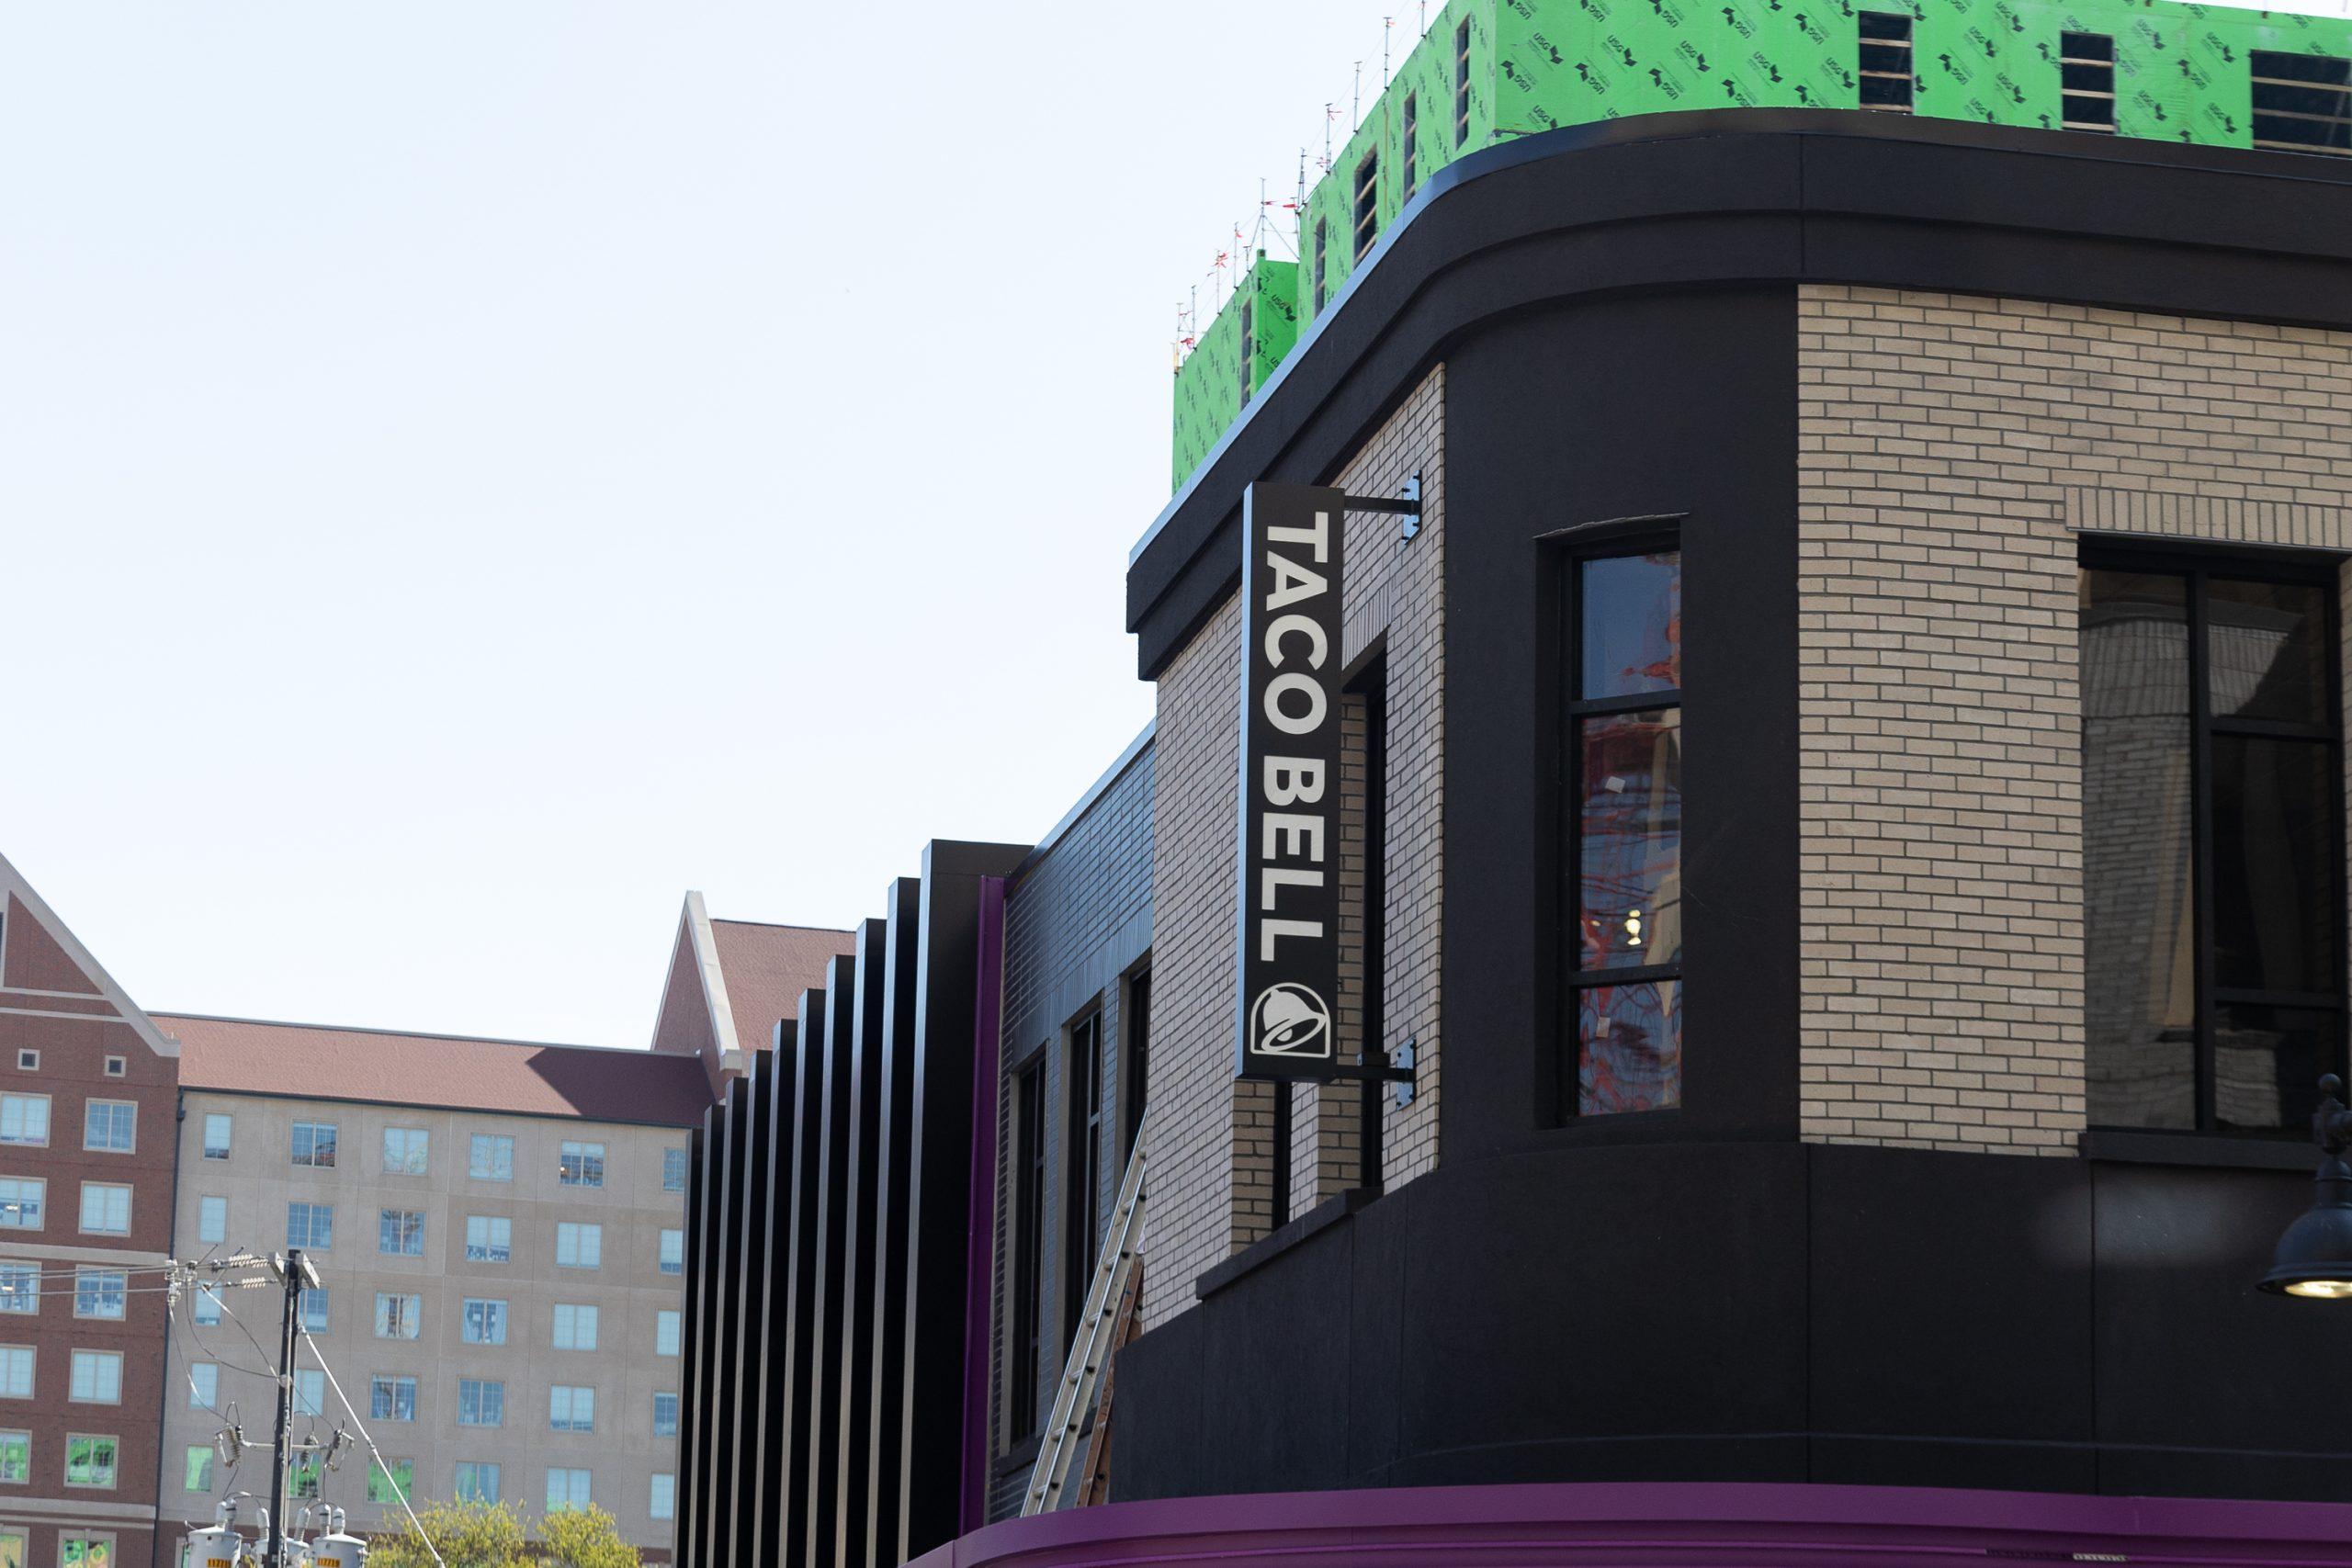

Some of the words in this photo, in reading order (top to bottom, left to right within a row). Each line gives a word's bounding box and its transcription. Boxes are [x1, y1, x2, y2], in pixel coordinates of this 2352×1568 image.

[1514, 3, 1532, 20] USG
[1589, 5, 1605, 23] USG
[1661, 10, 1679, 28] USG
[1532, 32, 1551, 51] USG
[1607, 35, 1624, 52] USG
[1680, 40, 1698, 58] USG
[1826, 57, 1842, 75] USG
[1514, 74, 1532, 93] USG
[1589, 77, 1605, 95] USG
[1661, 83, 1679, 100] USG
[1532, 105, 1551, 123] USG
[1272, 294, 1286, 310] USG
[1264, 512, 1329, 735] TACO
[1261, 755, 1326, 962] BELL
